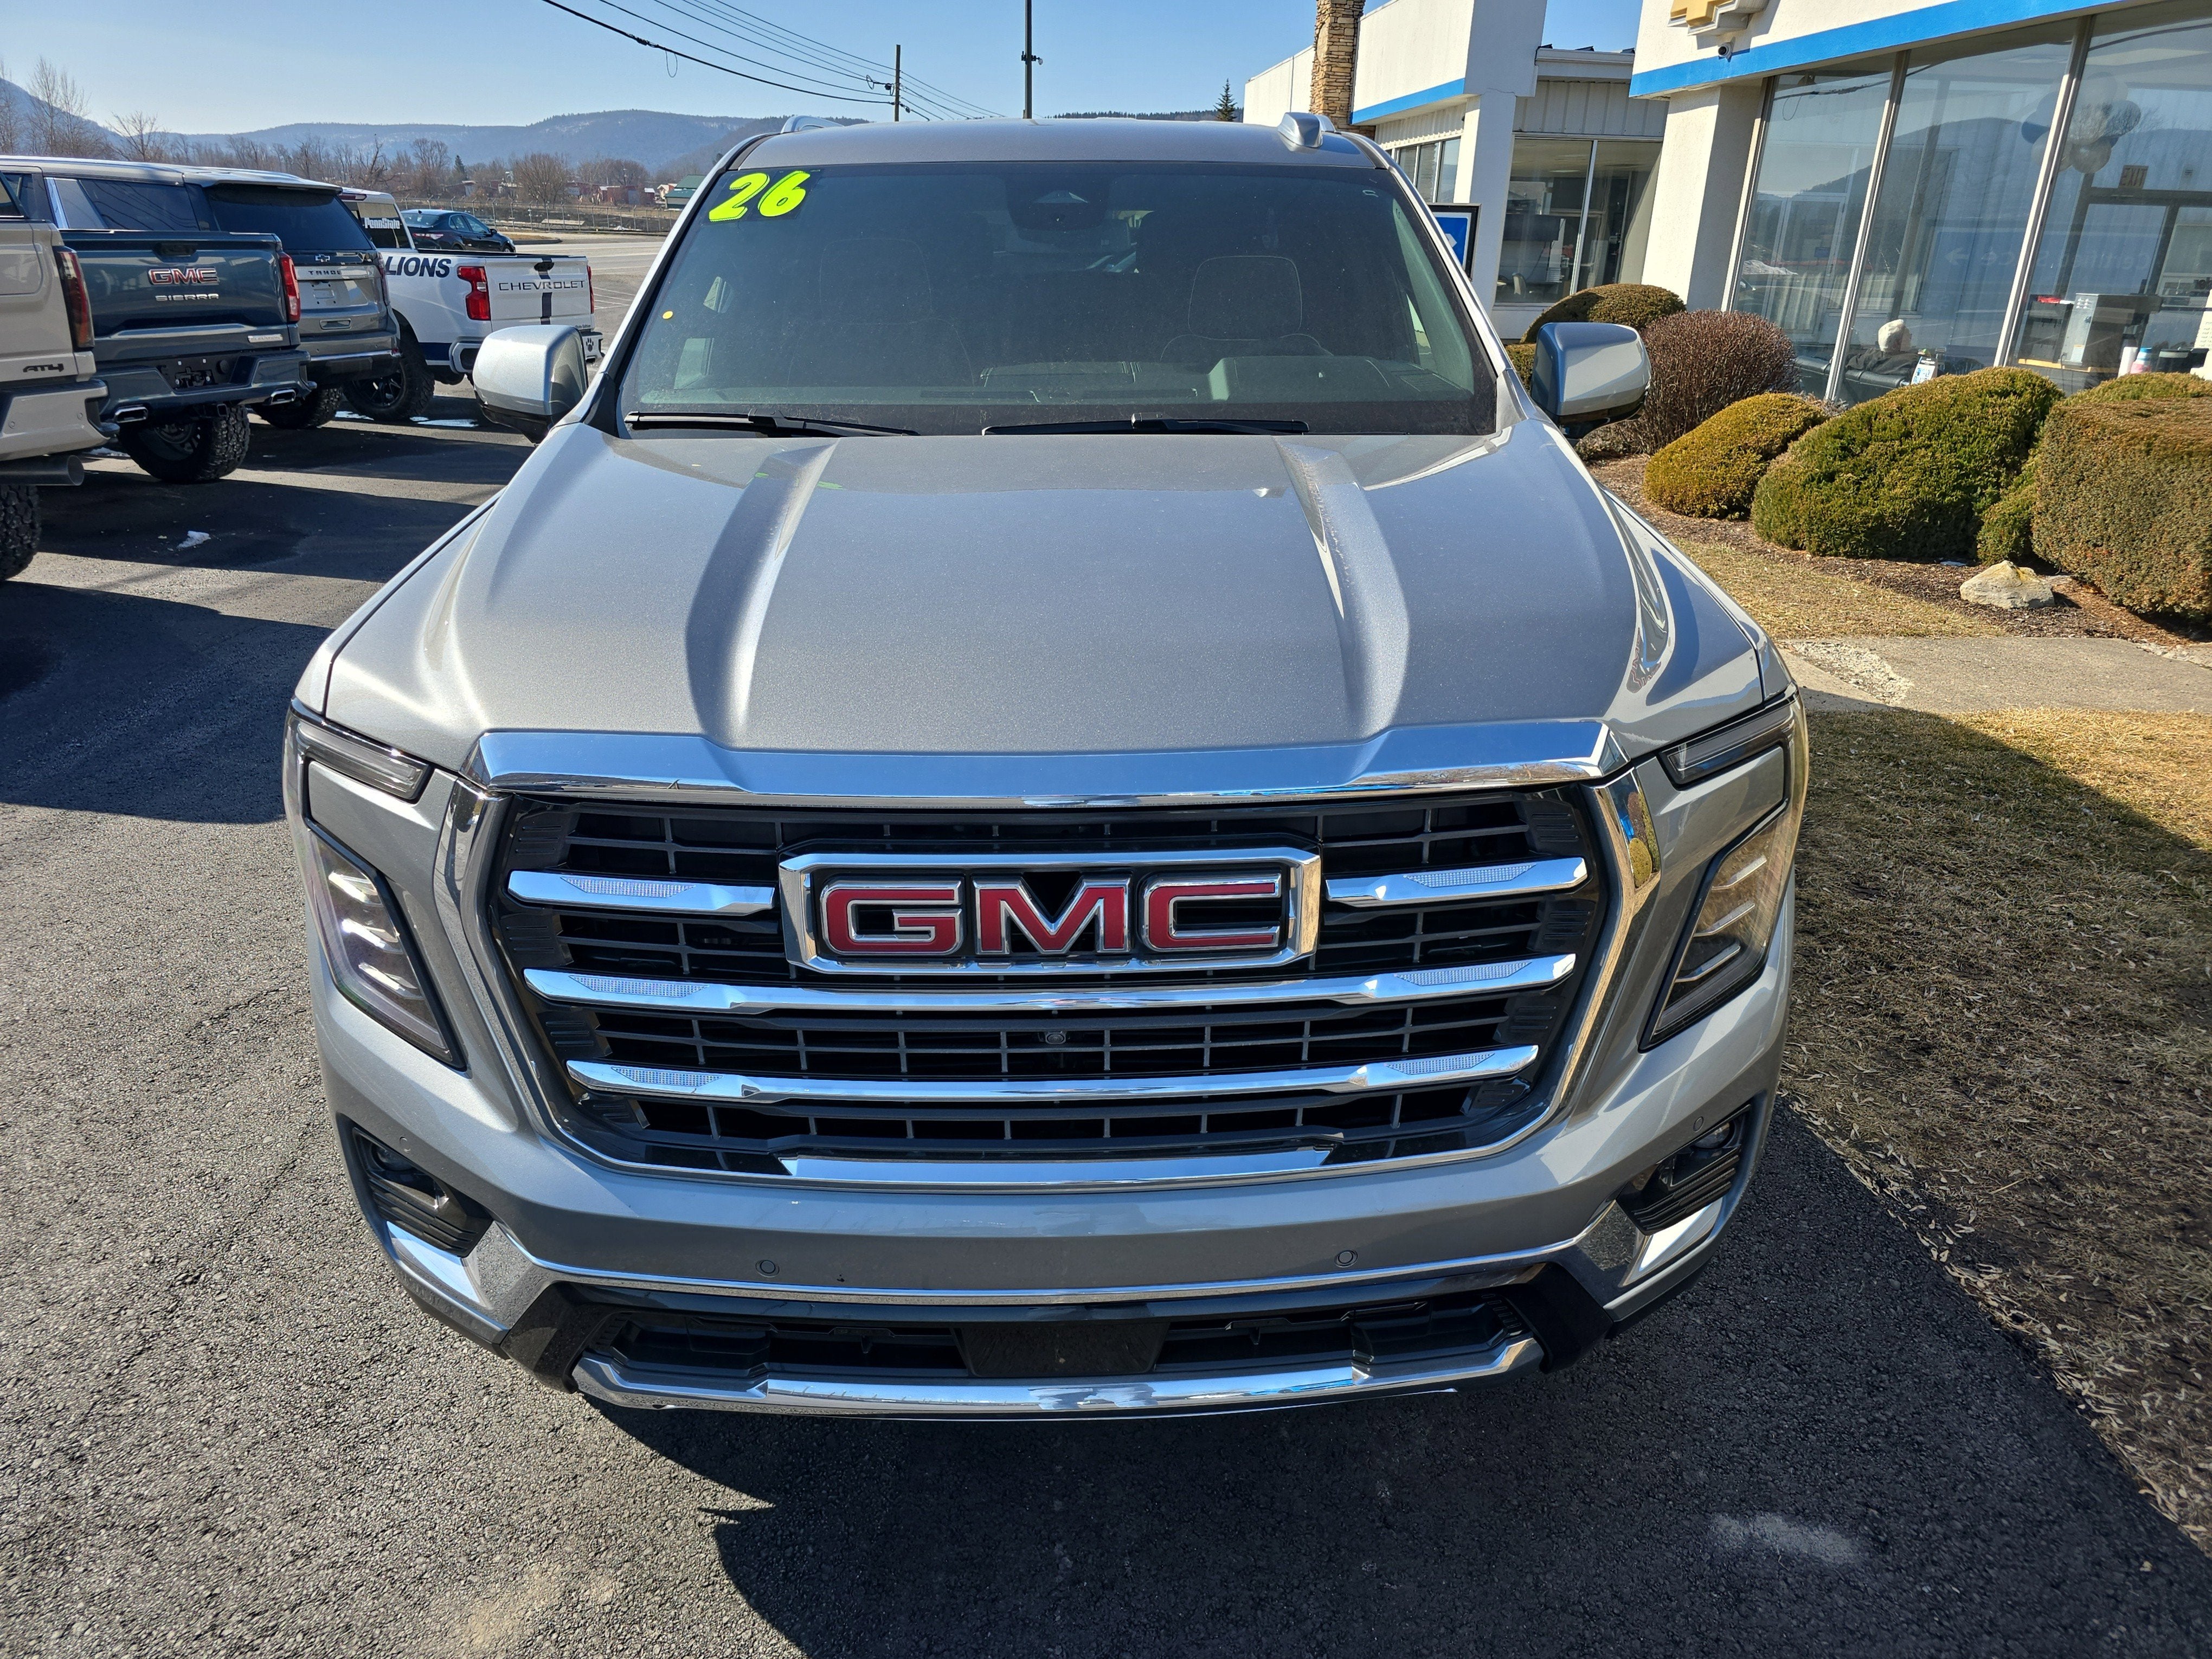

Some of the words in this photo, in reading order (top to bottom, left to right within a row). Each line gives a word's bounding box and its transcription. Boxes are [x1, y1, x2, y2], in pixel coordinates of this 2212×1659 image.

[2120, 167, 2147, 186] EXIT
[709, 171, 811, 222] 26
[147, 267, 220, 285] GMC
[385, 256, 452, 278] LIONS
[499, 280, 585, 291] CHEVROLET
[155, 293, 219, 301] SIERRA
[23, 363, 64, 372] AT4
[819, 872, 1282, 955] GMC
